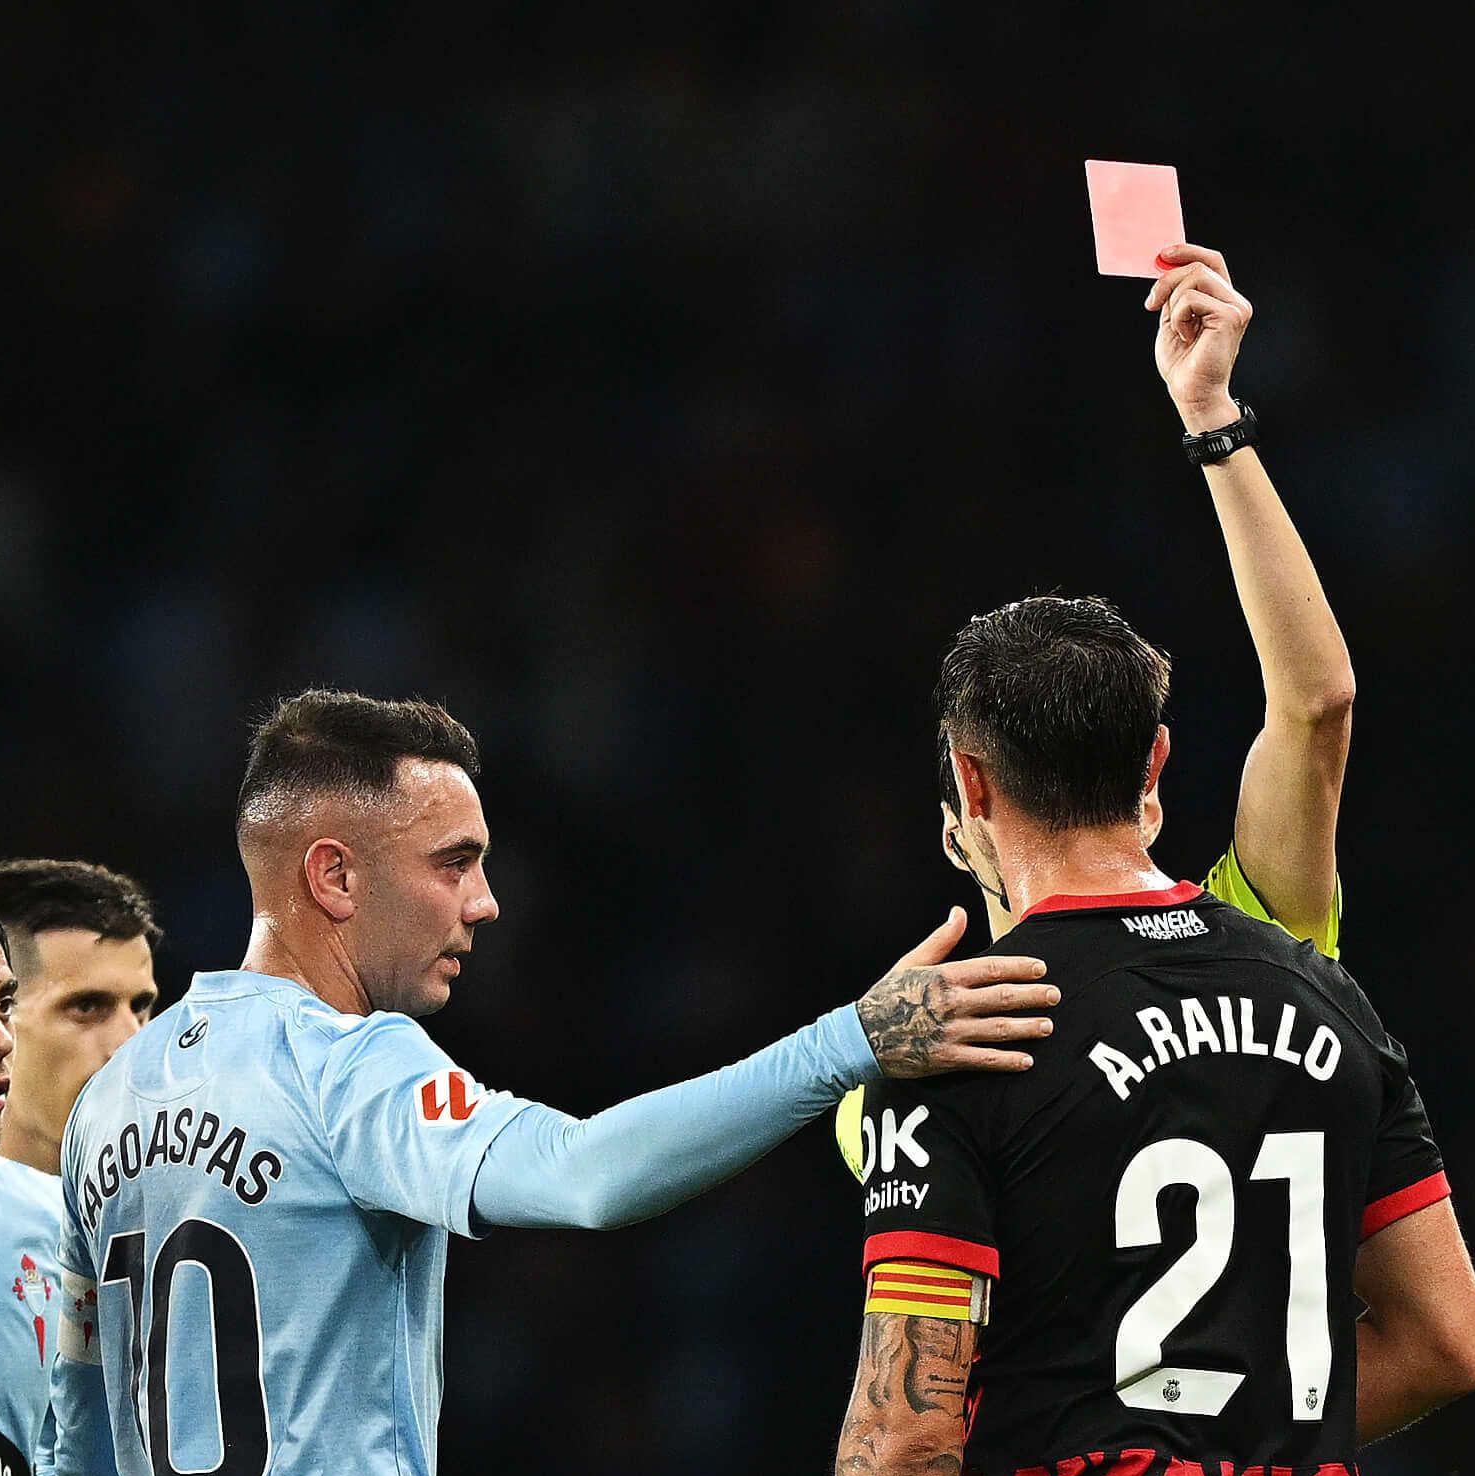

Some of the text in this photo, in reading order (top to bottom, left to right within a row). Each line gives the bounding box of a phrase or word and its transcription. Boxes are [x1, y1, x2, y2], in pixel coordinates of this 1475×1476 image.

[1121, 910, 1205, 933] JUANEDA
[1146, 925, 1210, 940] HOSPITALES
[1088, 996, 1342, 1101] A.RAILLO
[79, 1107, 282, 1238] AGO ASPAS
[865, 1179, 930, 1217] obility
[1115, 1131, 1331, 1421] 21
